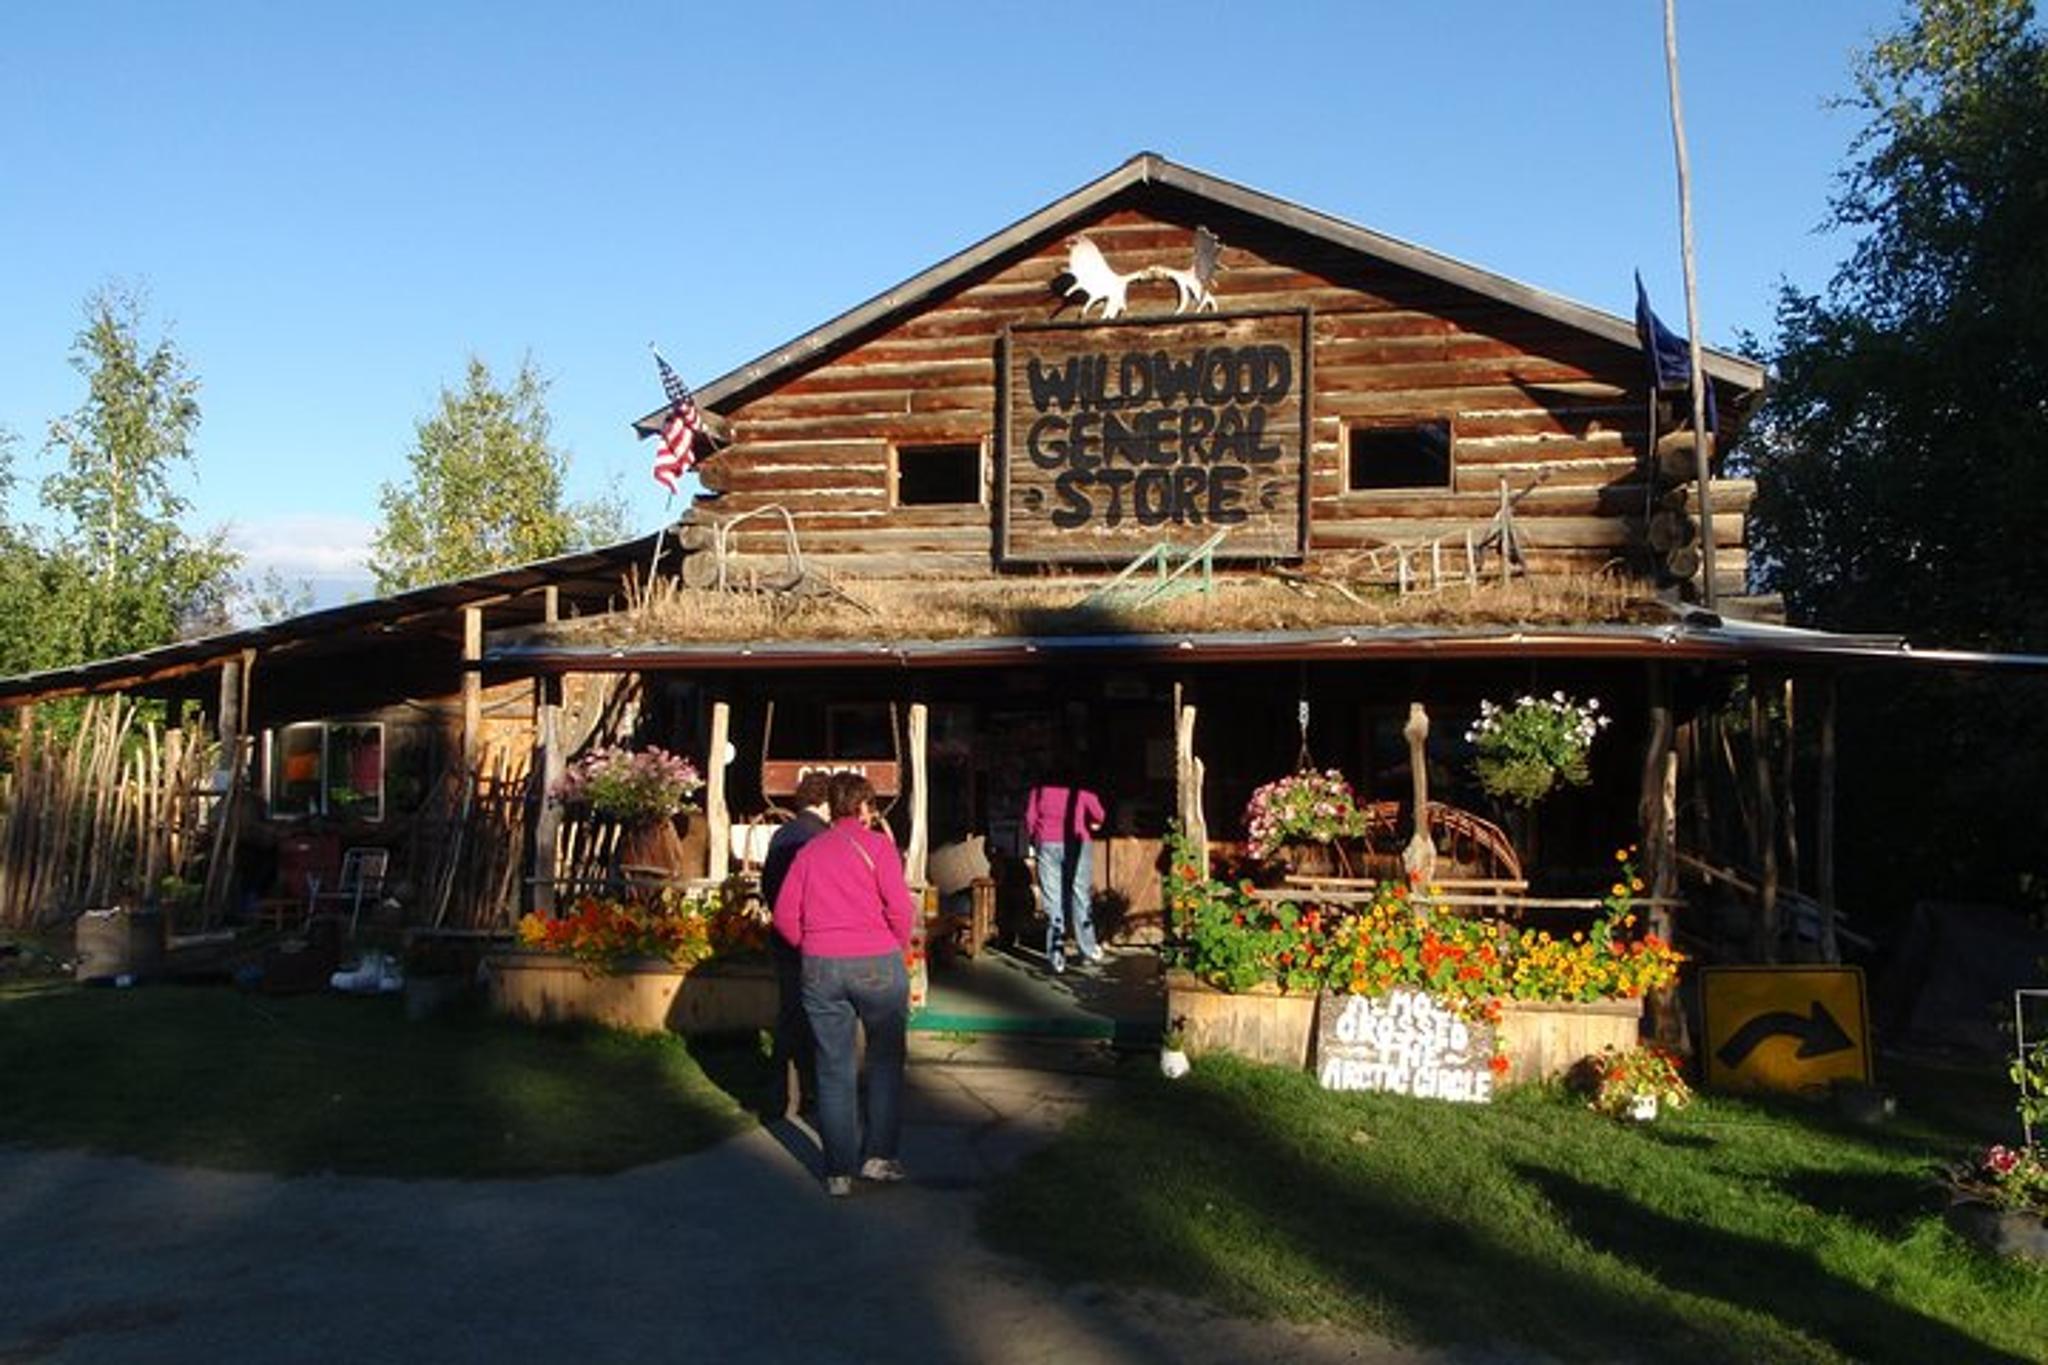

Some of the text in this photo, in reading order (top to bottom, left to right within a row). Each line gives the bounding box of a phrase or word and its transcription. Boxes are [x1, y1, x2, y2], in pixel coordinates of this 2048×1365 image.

[1027, 345, 1293, 412] WILDWOOD
[1027, 405, 1282, 468] GENERAL
[1051, 467, 1248, 528] STORE
[1321, 1057, 1492, 1103] ARCTIC CIRCLE
